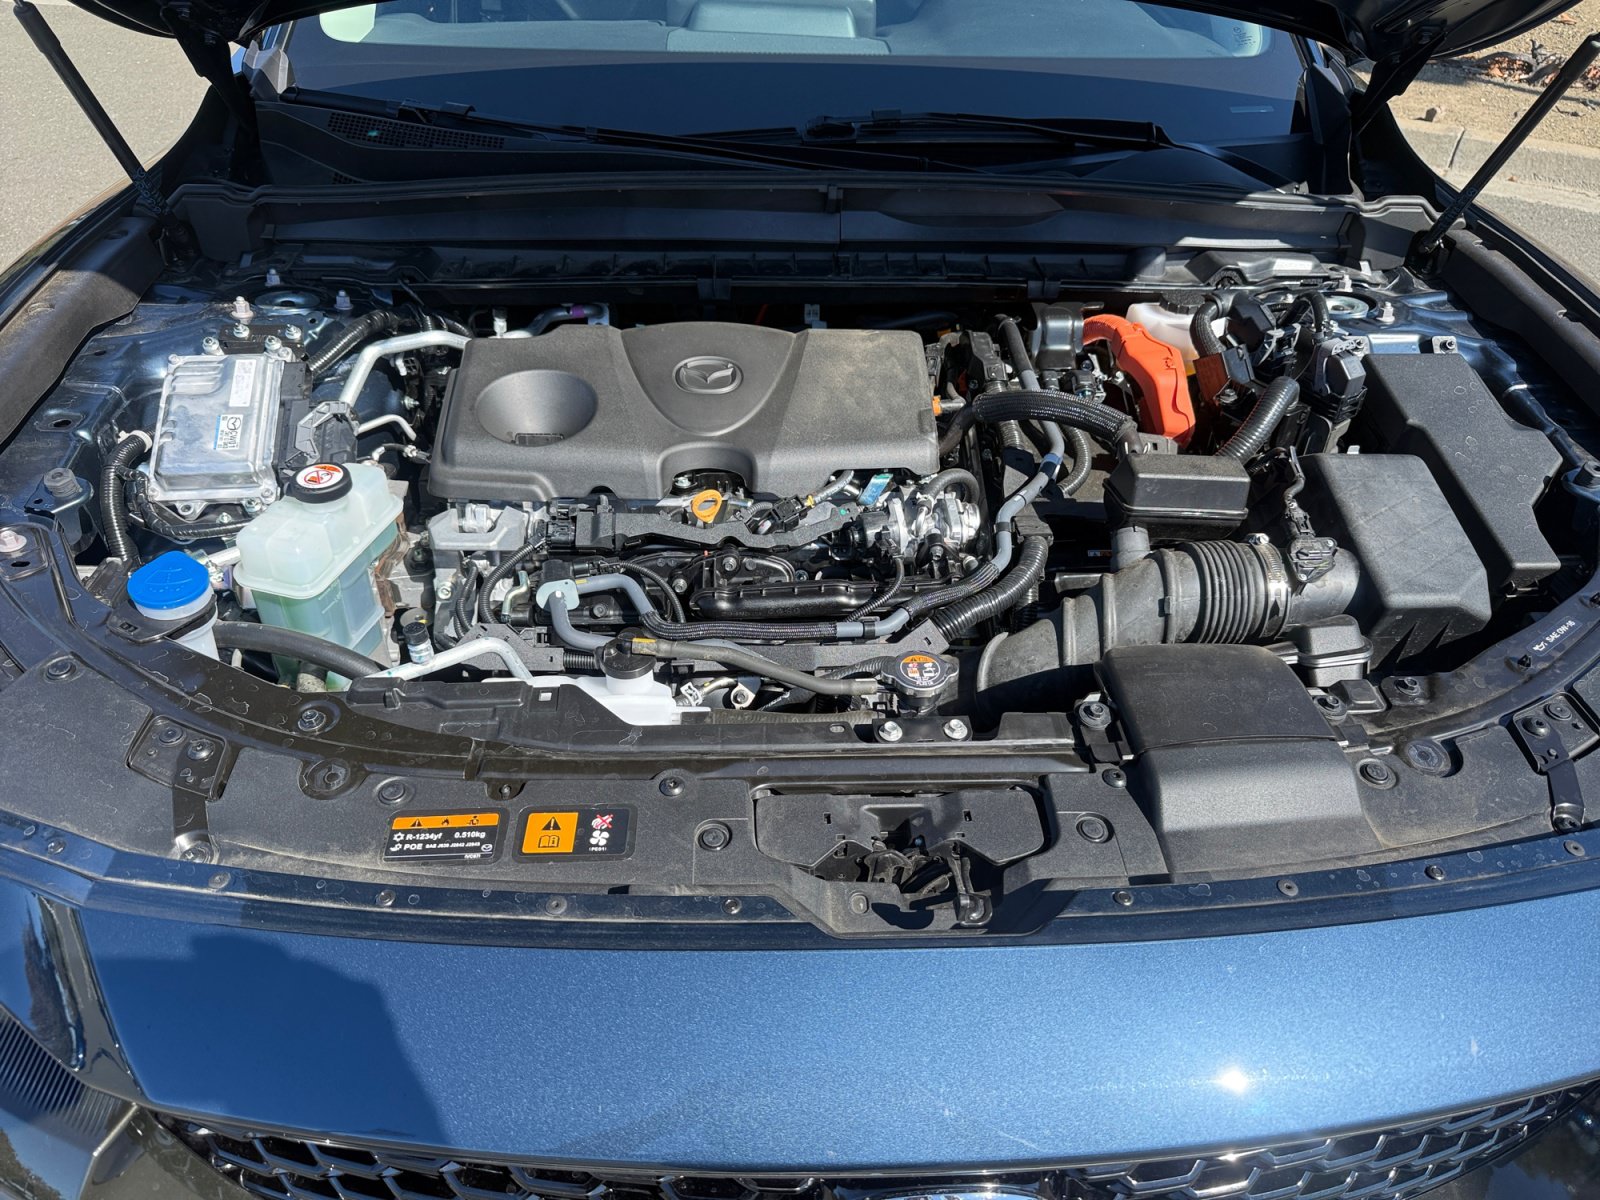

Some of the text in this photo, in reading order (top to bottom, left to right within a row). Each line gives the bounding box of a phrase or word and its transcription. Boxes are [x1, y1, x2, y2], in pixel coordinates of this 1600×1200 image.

[1545, 631, 1561, 643] SAE
[405, 832, 442, 841] R-1234yf
[454, 831, 486, 839] 0.510kg
